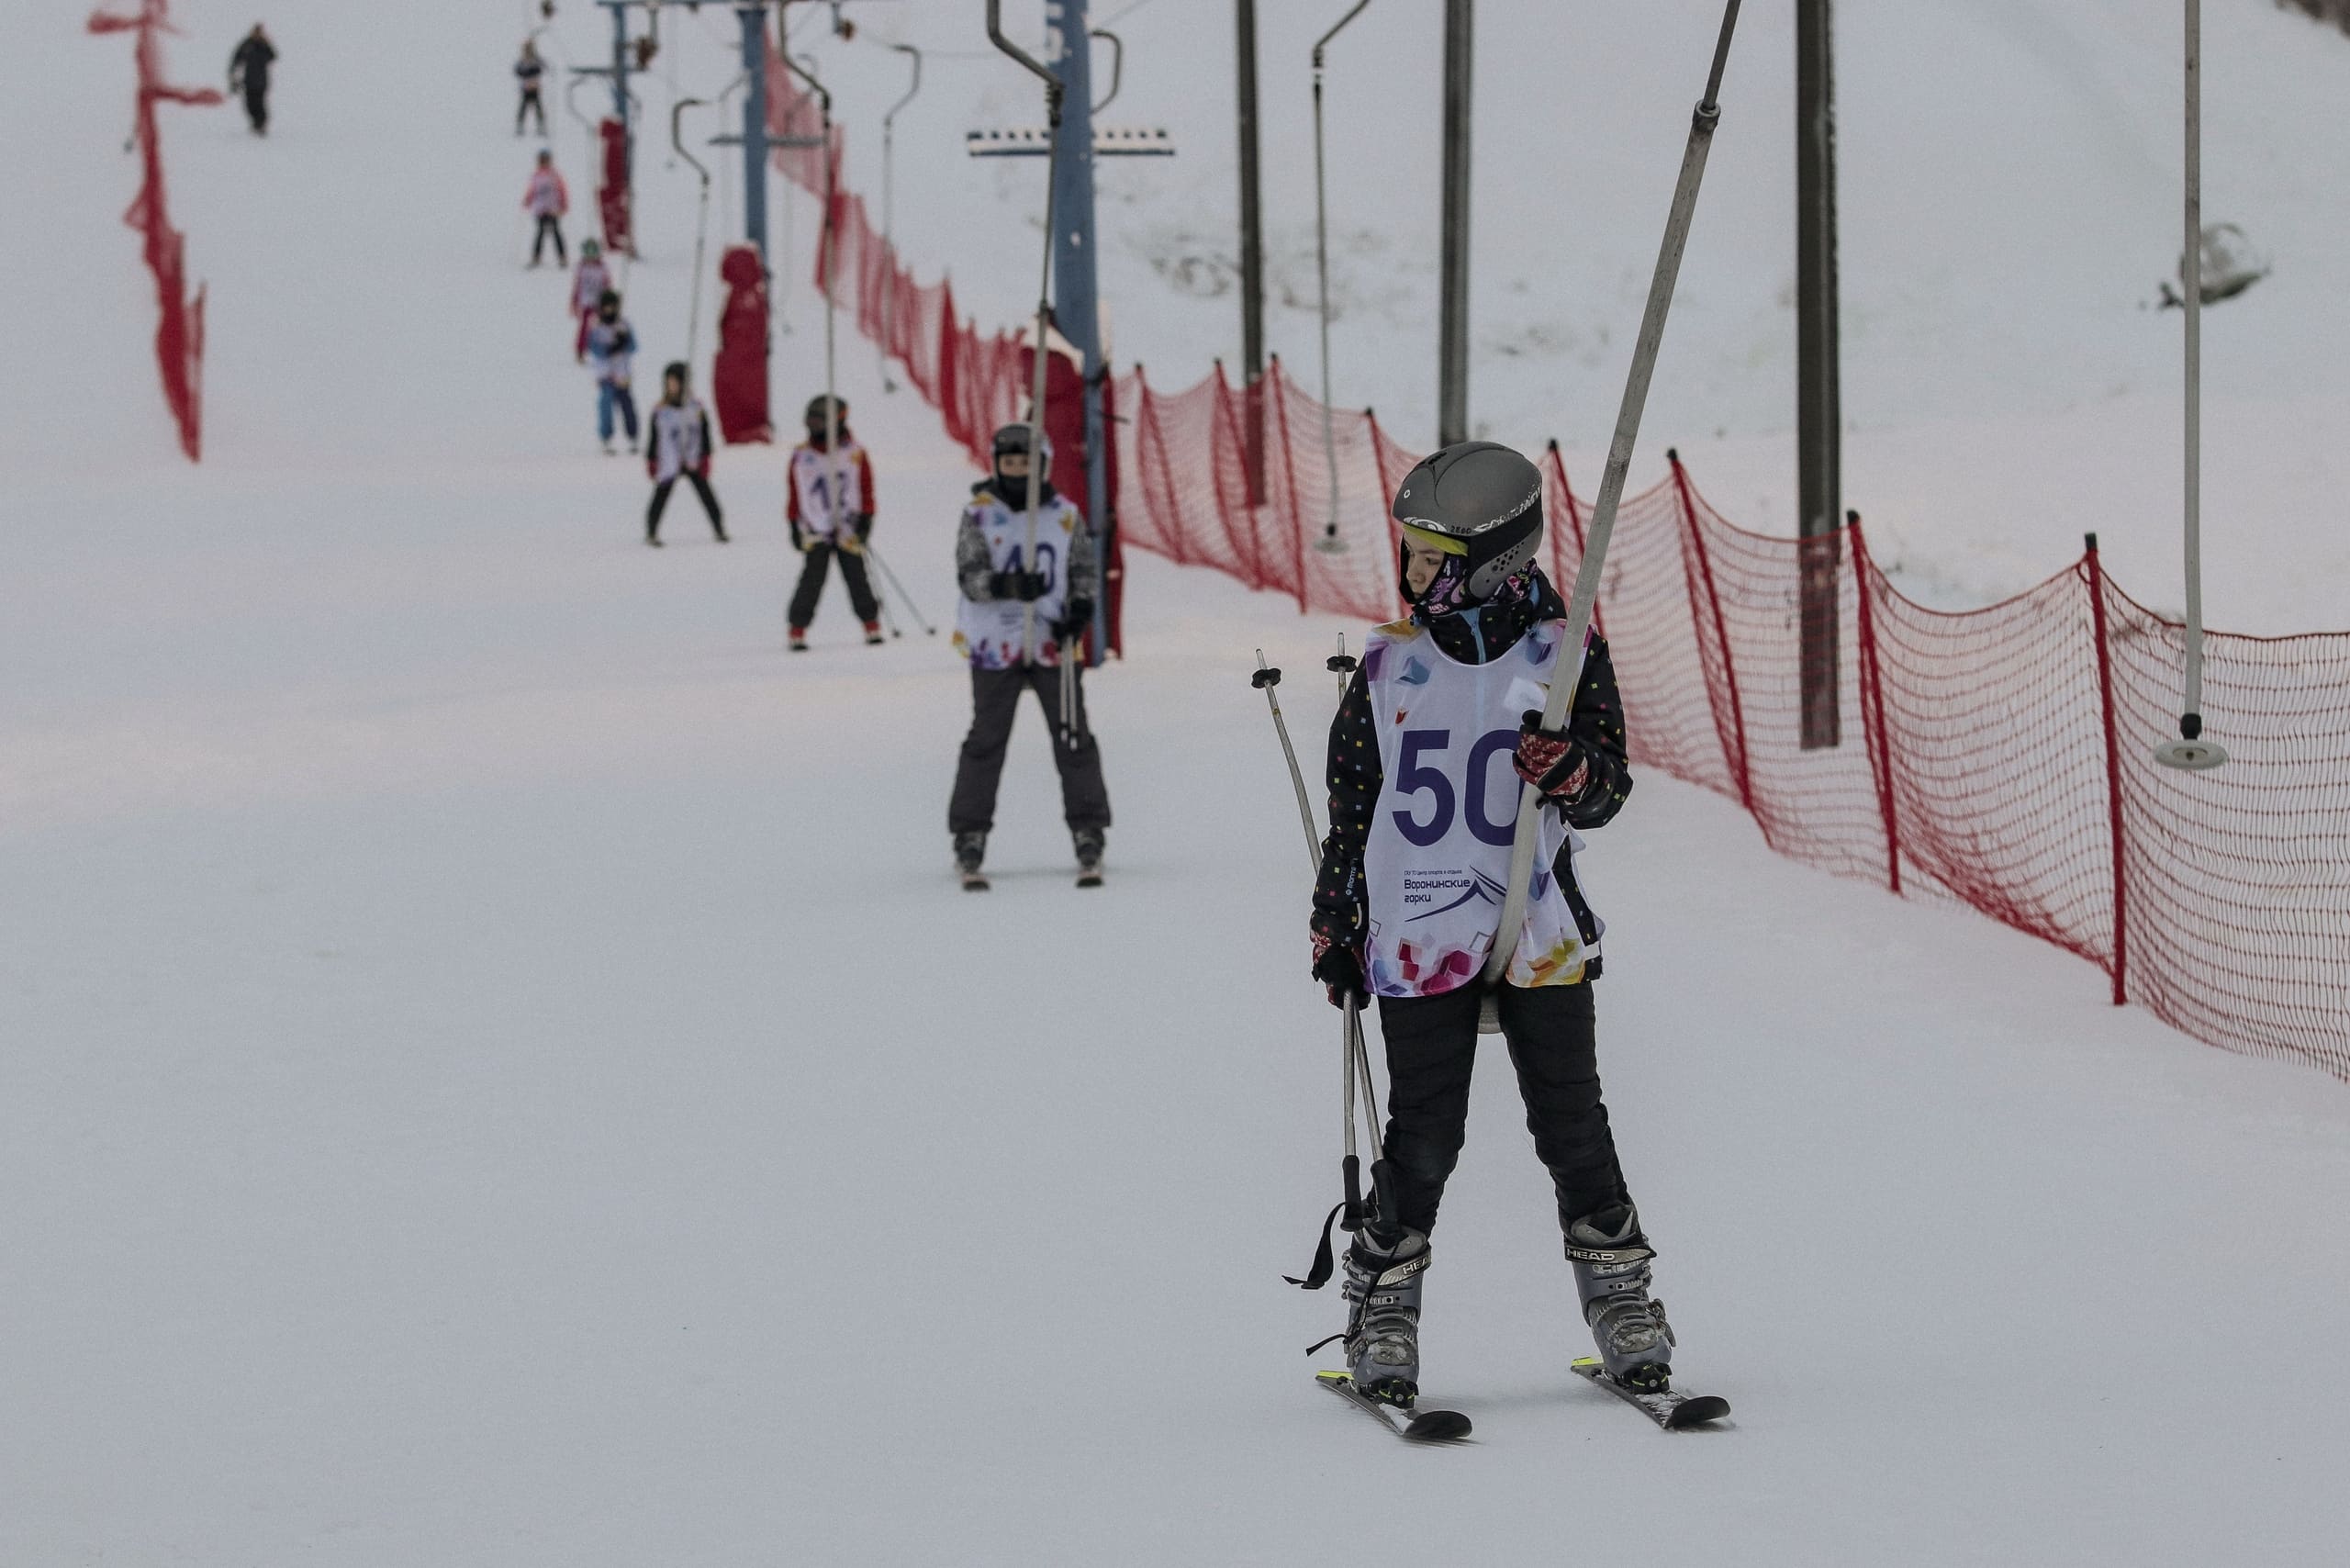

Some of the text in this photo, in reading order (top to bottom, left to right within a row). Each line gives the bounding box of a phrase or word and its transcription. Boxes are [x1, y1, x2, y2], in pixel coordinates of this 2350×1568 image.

[1392, 729, 1525, 846] 50
[1404, 879, 1471, 892] Воронинские
[1404, 893, 1431, 906] горки
[1566, 1248, 1616, 1261] HEAD
